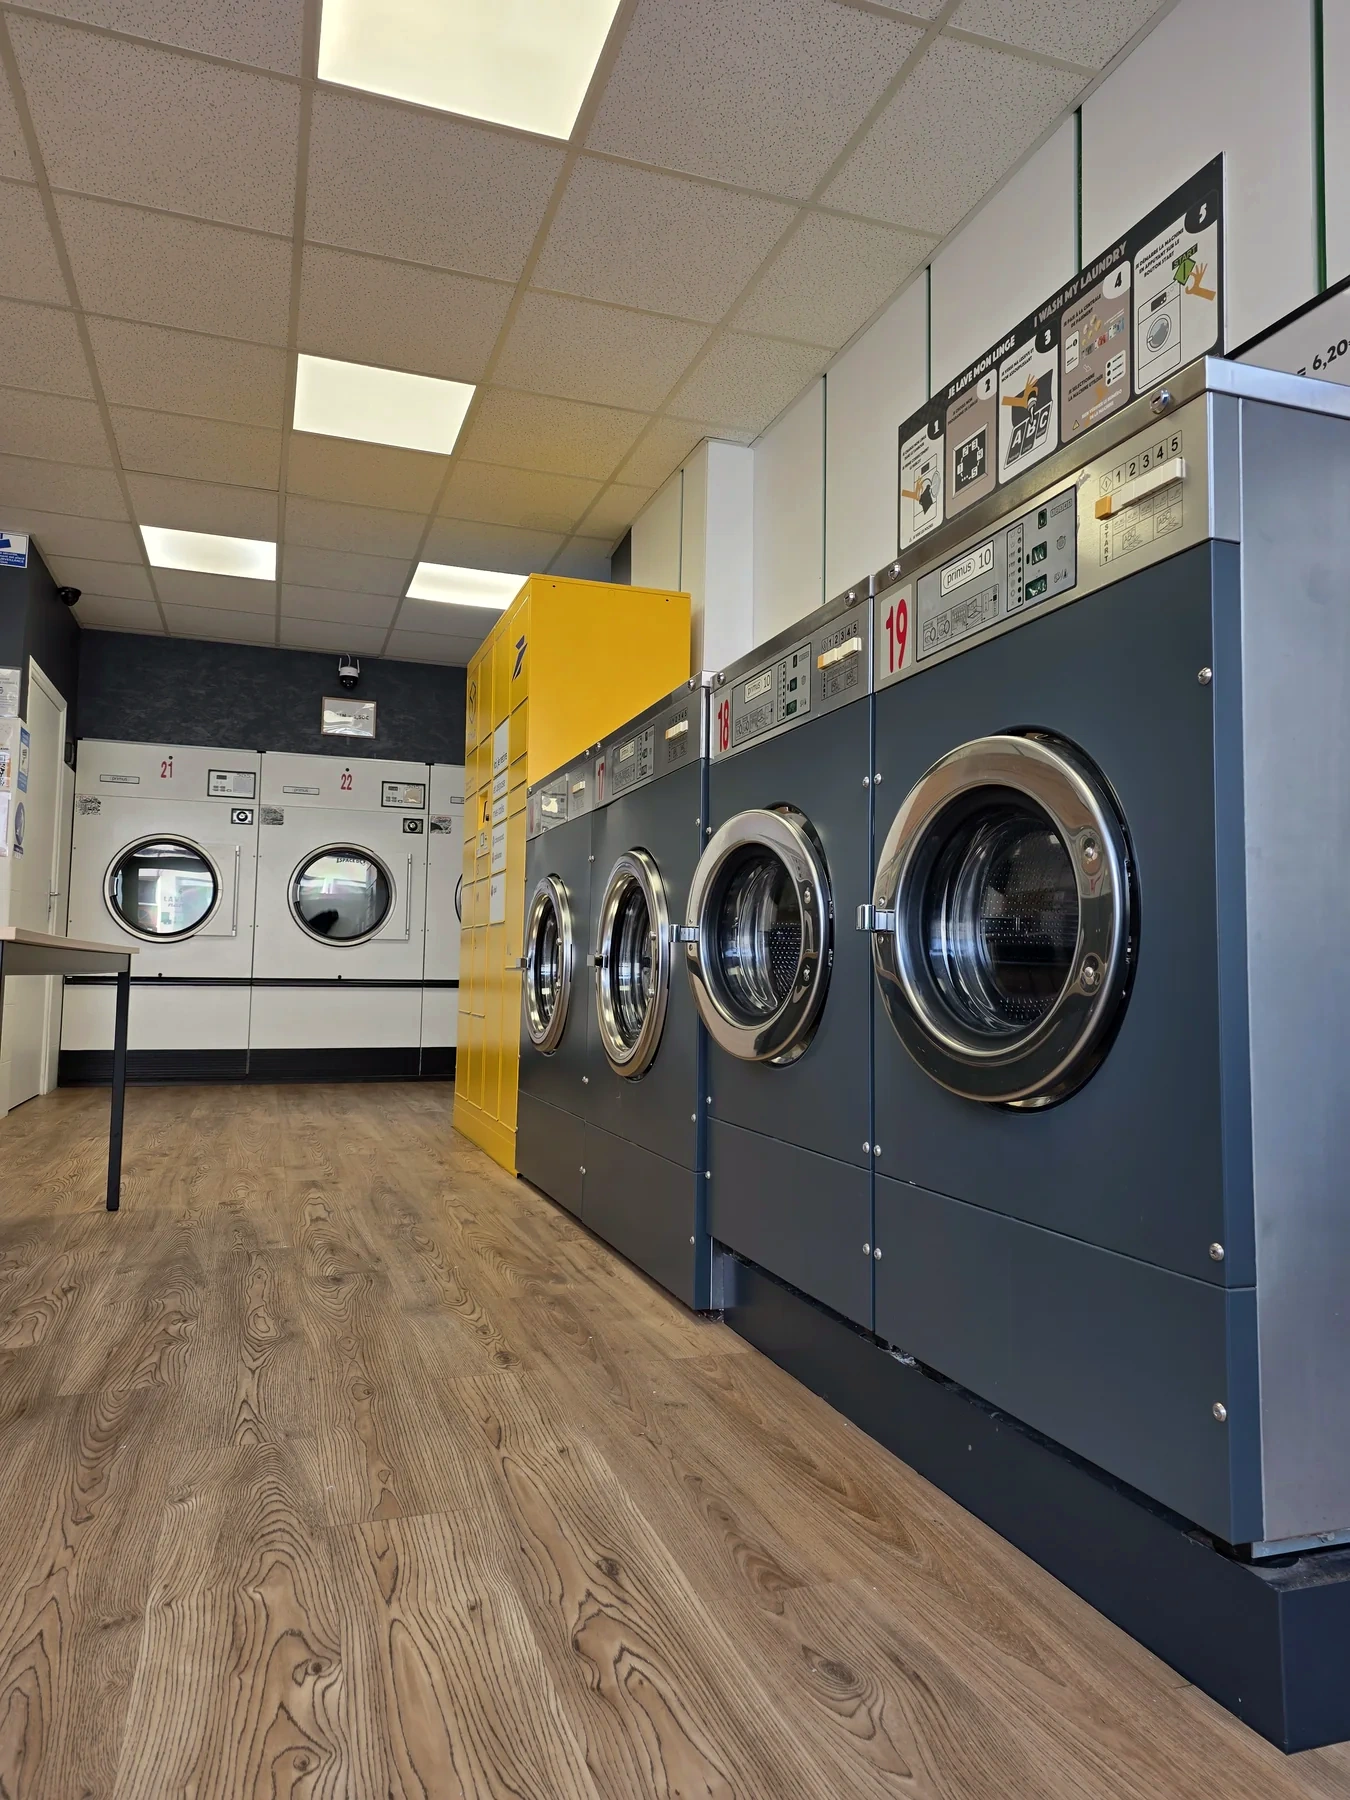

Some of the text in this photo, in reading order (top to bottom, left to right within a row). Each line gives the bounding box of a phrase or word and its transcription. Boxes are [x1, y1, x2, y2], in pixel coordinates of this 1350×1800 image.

[1199, 203, 1207, 224] 5
[1173, 244, 1196, 268] START
[1038, 294, 1062, 324] WASH
[1064, 279, 1079, 303] MY
[1080, 240, 1126, 289] LAUNDRY
[1114, 271, 1122, 288] 4
[1044, 329, 1051, 346] 3
[948, 334, 1014, 399] JE LAVE MON LINGE
[1312, 339, 1350, 370] 6,20
[985, 379, 991, 393] 2
[934, 420, 940, 434] 1
[1011, 429, 1020, 448] A
[1039, 409, 1048, 429] C
[1116, 437, 1178, 482] 1 2 3 4 5
[947, 548, 992, 586] primus 10
[886, 598, 908, 673] 19
[747, 674, 770, 696] primus 10
[718, 699, 730, 752] 18
[160, 761, 173, 778] 21
[341, 774, 353, 790] 22
